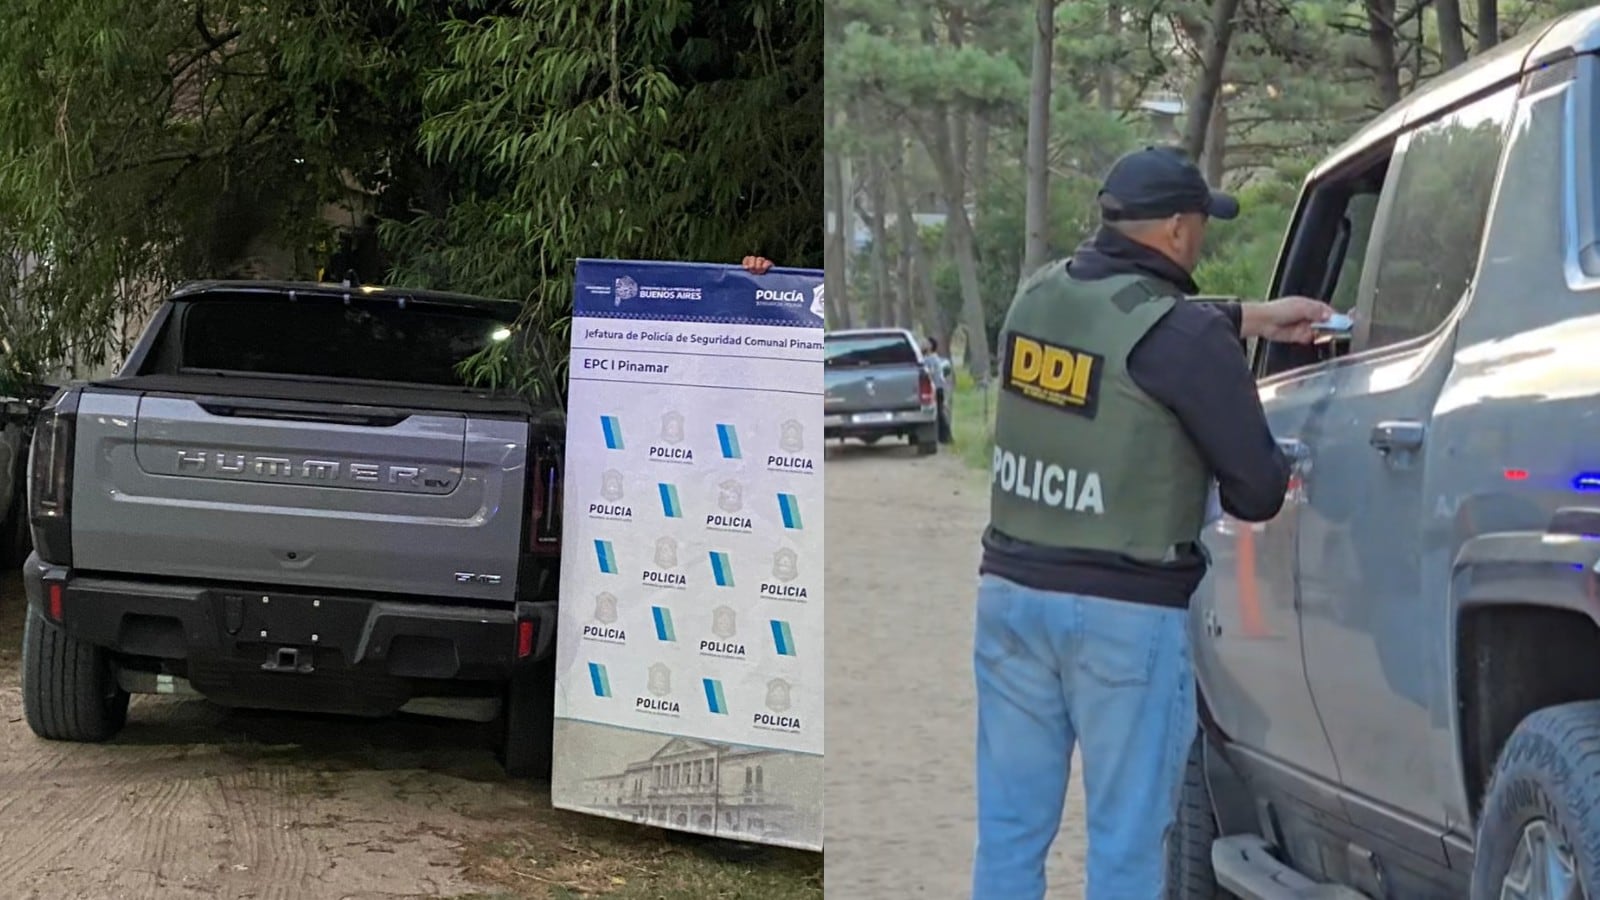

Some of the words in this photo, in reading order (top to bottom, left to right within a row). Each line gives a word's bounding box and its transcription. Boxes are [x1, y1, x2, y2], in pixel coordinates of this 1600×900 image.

[640, 290, 674, 300] BUENOS
[676, 291, 702, 301] AIRES
[755, 289, 804, 302] POLICÍA
[585, 328, 623, 339] Jefatura
[626, 331, 638, 340] de
[641, 331, 673, 341] Policía
[676, 333, 688, 342] de
[690, 334, 742, 345] Seguridad
[744, 336, 788, 348] Comunal
[790, 339, 824, 350] Pinam
[584, 358, 609, 370] EPC
[618, 360, 669, 372] Pinamar
[1011, 336, 1094, 398] DDI
[650, 446, 693, 459] POLICIA
[178, 451, 420, 485] HUMMER
[767, 456, 814, 469] POLICIA
[992, 446, 1104, 514] POLICIA
[589, 503, 632, 517] POLICIA
[706, 515, 752, 528] POLICIA
[642, 571, 687, 584] POLICIA
[760, 584, 808, 598] POLICIA
[583, 626, 626, 640] POLICIA
[700, 641, 746, 655] POLICIA
[636, 698, 680, 712] POLICIA
[753, 713, 801, 728] POLICIA
